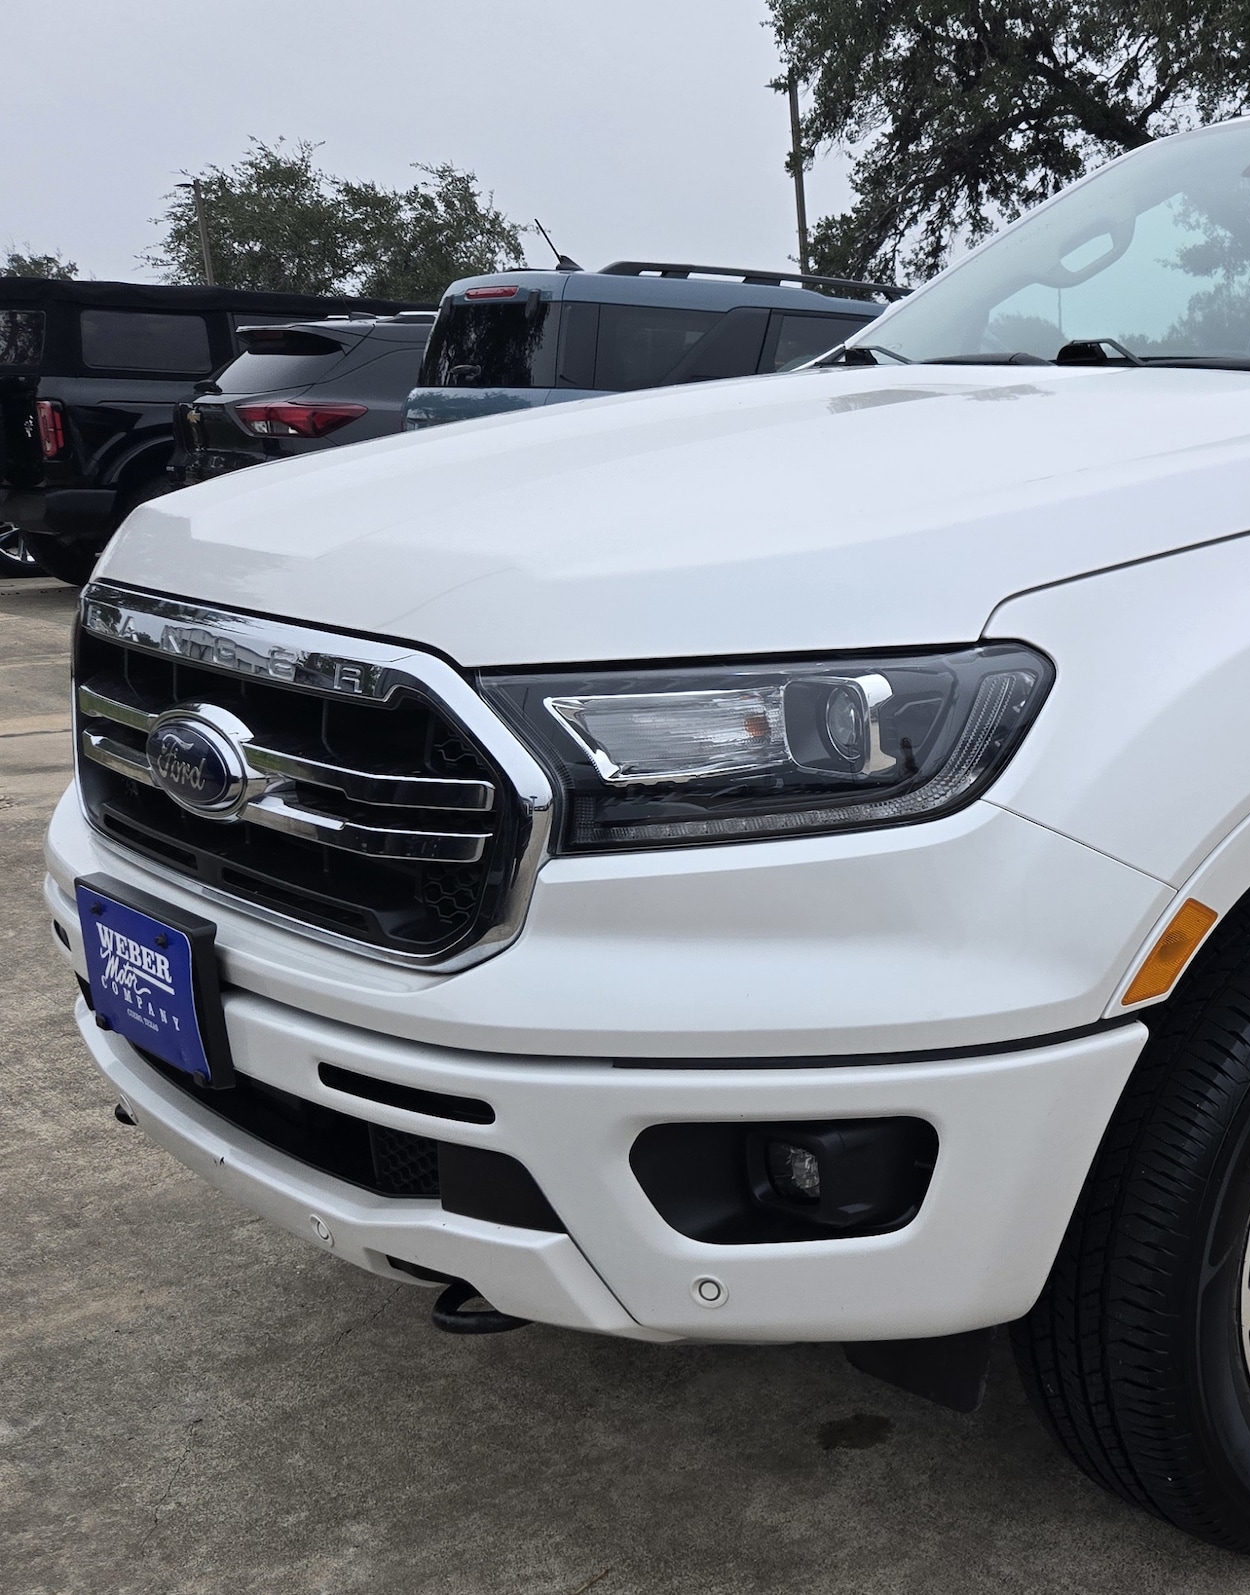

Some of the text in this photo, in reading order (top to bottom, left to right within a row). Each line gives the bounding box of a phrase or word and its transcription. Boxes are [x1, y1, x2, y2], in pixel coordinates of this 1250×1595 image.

[88, 603, 363, 694] RANGER
[157, 733, 206, 791] Ford
[96, 921, 172, 983] WEBER
[100, 947, 154, 995] Motor
[101, 975, 180, 1031] COMPANY
